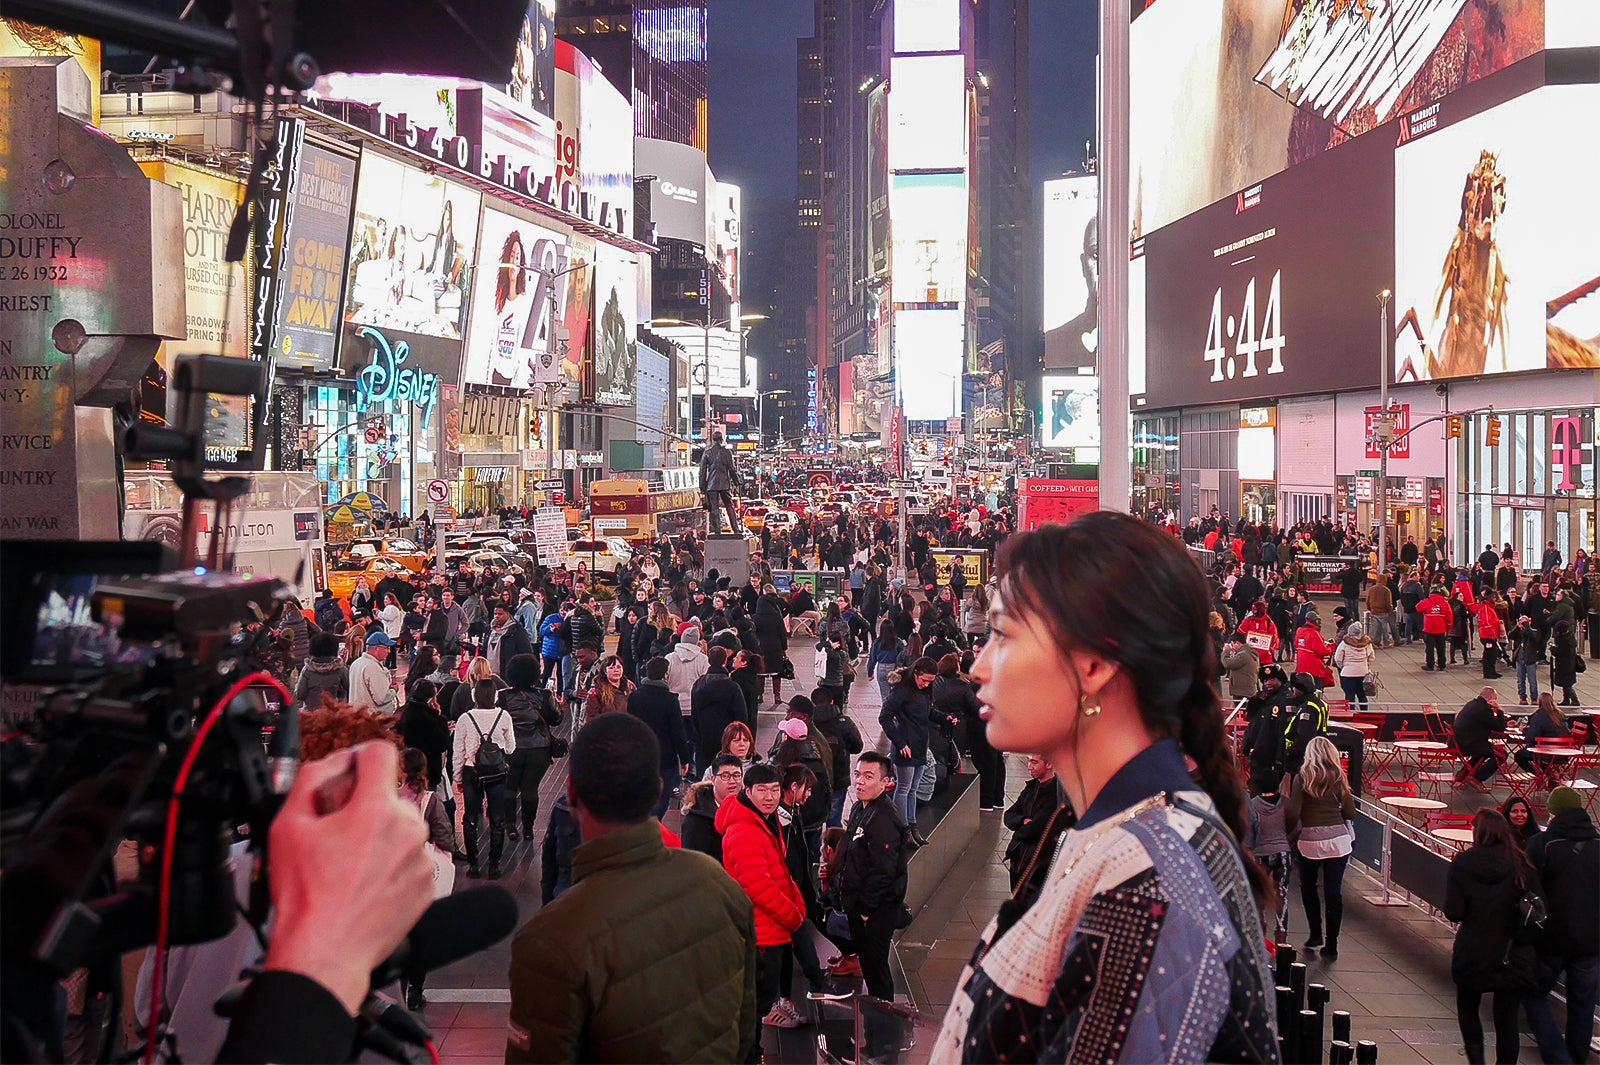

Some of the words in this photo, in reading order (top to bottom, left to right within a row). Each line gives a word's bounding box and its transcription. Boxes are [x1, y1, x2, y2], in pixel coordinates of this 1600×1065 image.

[1411, 118, 1437, 136] MARQUIS
[176, 181, 239, 231] HARRY
[0, 237, 83, 259] DUFFY
[294, 238, 344, 274] COME
[12, 266, 29, 281] 26
[34, 266, 68, 281] 1932
[186, 267, 211, 284] URSED
[289, 265, 340, 302] FROM
[699, 269, 707, 305] 1500
[285, 295, 337, 330] AWAY
[1204, 268, 1286, 383] 4:44
[460, 395, 521, 436] FOREVER
[1552, 416, 1582, 490] T
[1029, 484, 1066, 492] COFFEED
[25, 517, 60, 530] WAR
[203, 523, 275, 539] HAMILTON
[936, 563, 979, 576] Beful
